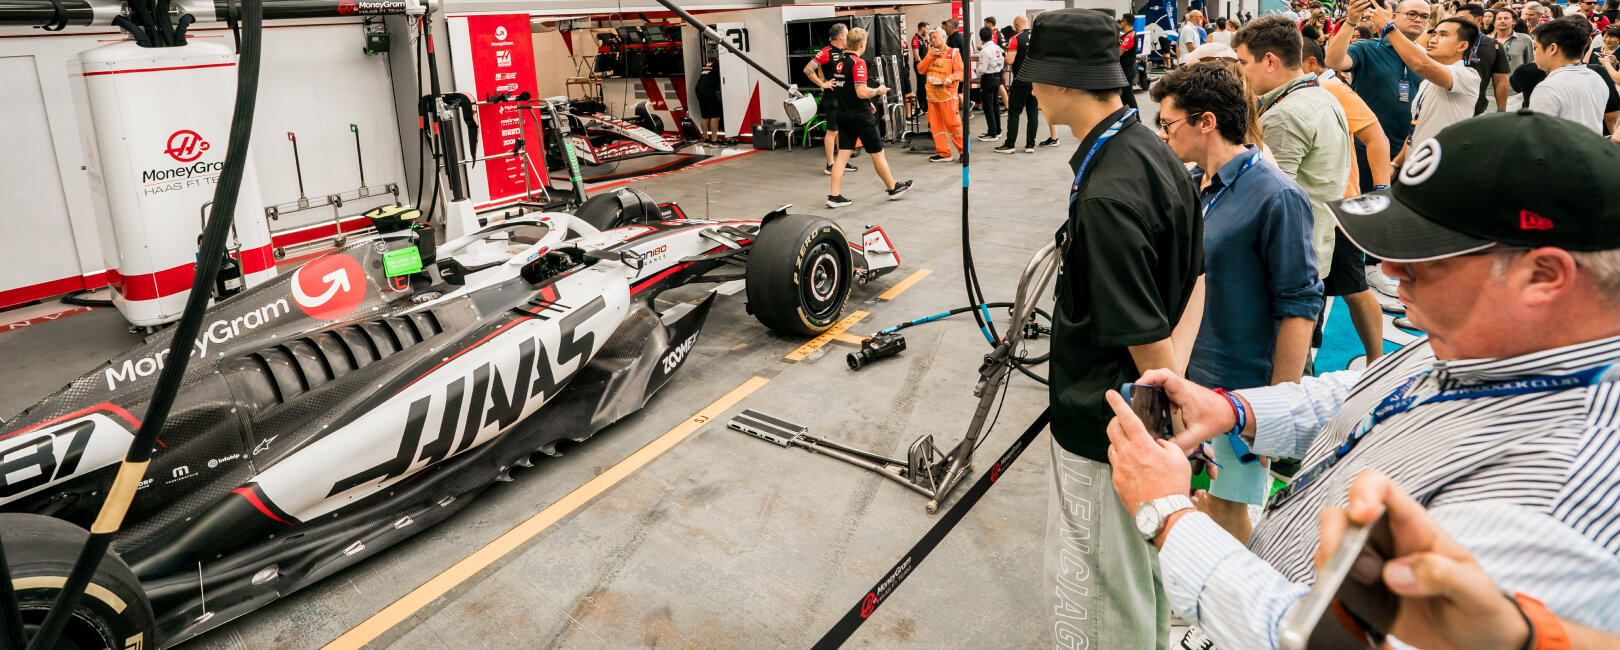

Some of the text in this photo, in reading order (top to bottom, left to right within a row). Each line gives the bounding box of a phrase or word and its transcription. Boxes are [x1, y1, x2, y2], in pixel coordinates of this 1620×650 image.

[359, 1, 406, 9] MoneyGram
[726, 28, 750, 52] 31
[142, 161, 224, 184] MoneyGra
[144, 176, 220, 197] HAAS F1 TE
[105, 298, 290, 391] MonyGram
[662, 329, 700, 375] ZOOMEX
[325, 294, 607, 499] HAAS
[0, 419, 96, 498] 87
[218, 452, 240, 464] infobip
[1053, 450, 1092, 650] LENCIAG
[876, 556, 912, 595] MoneyGram
